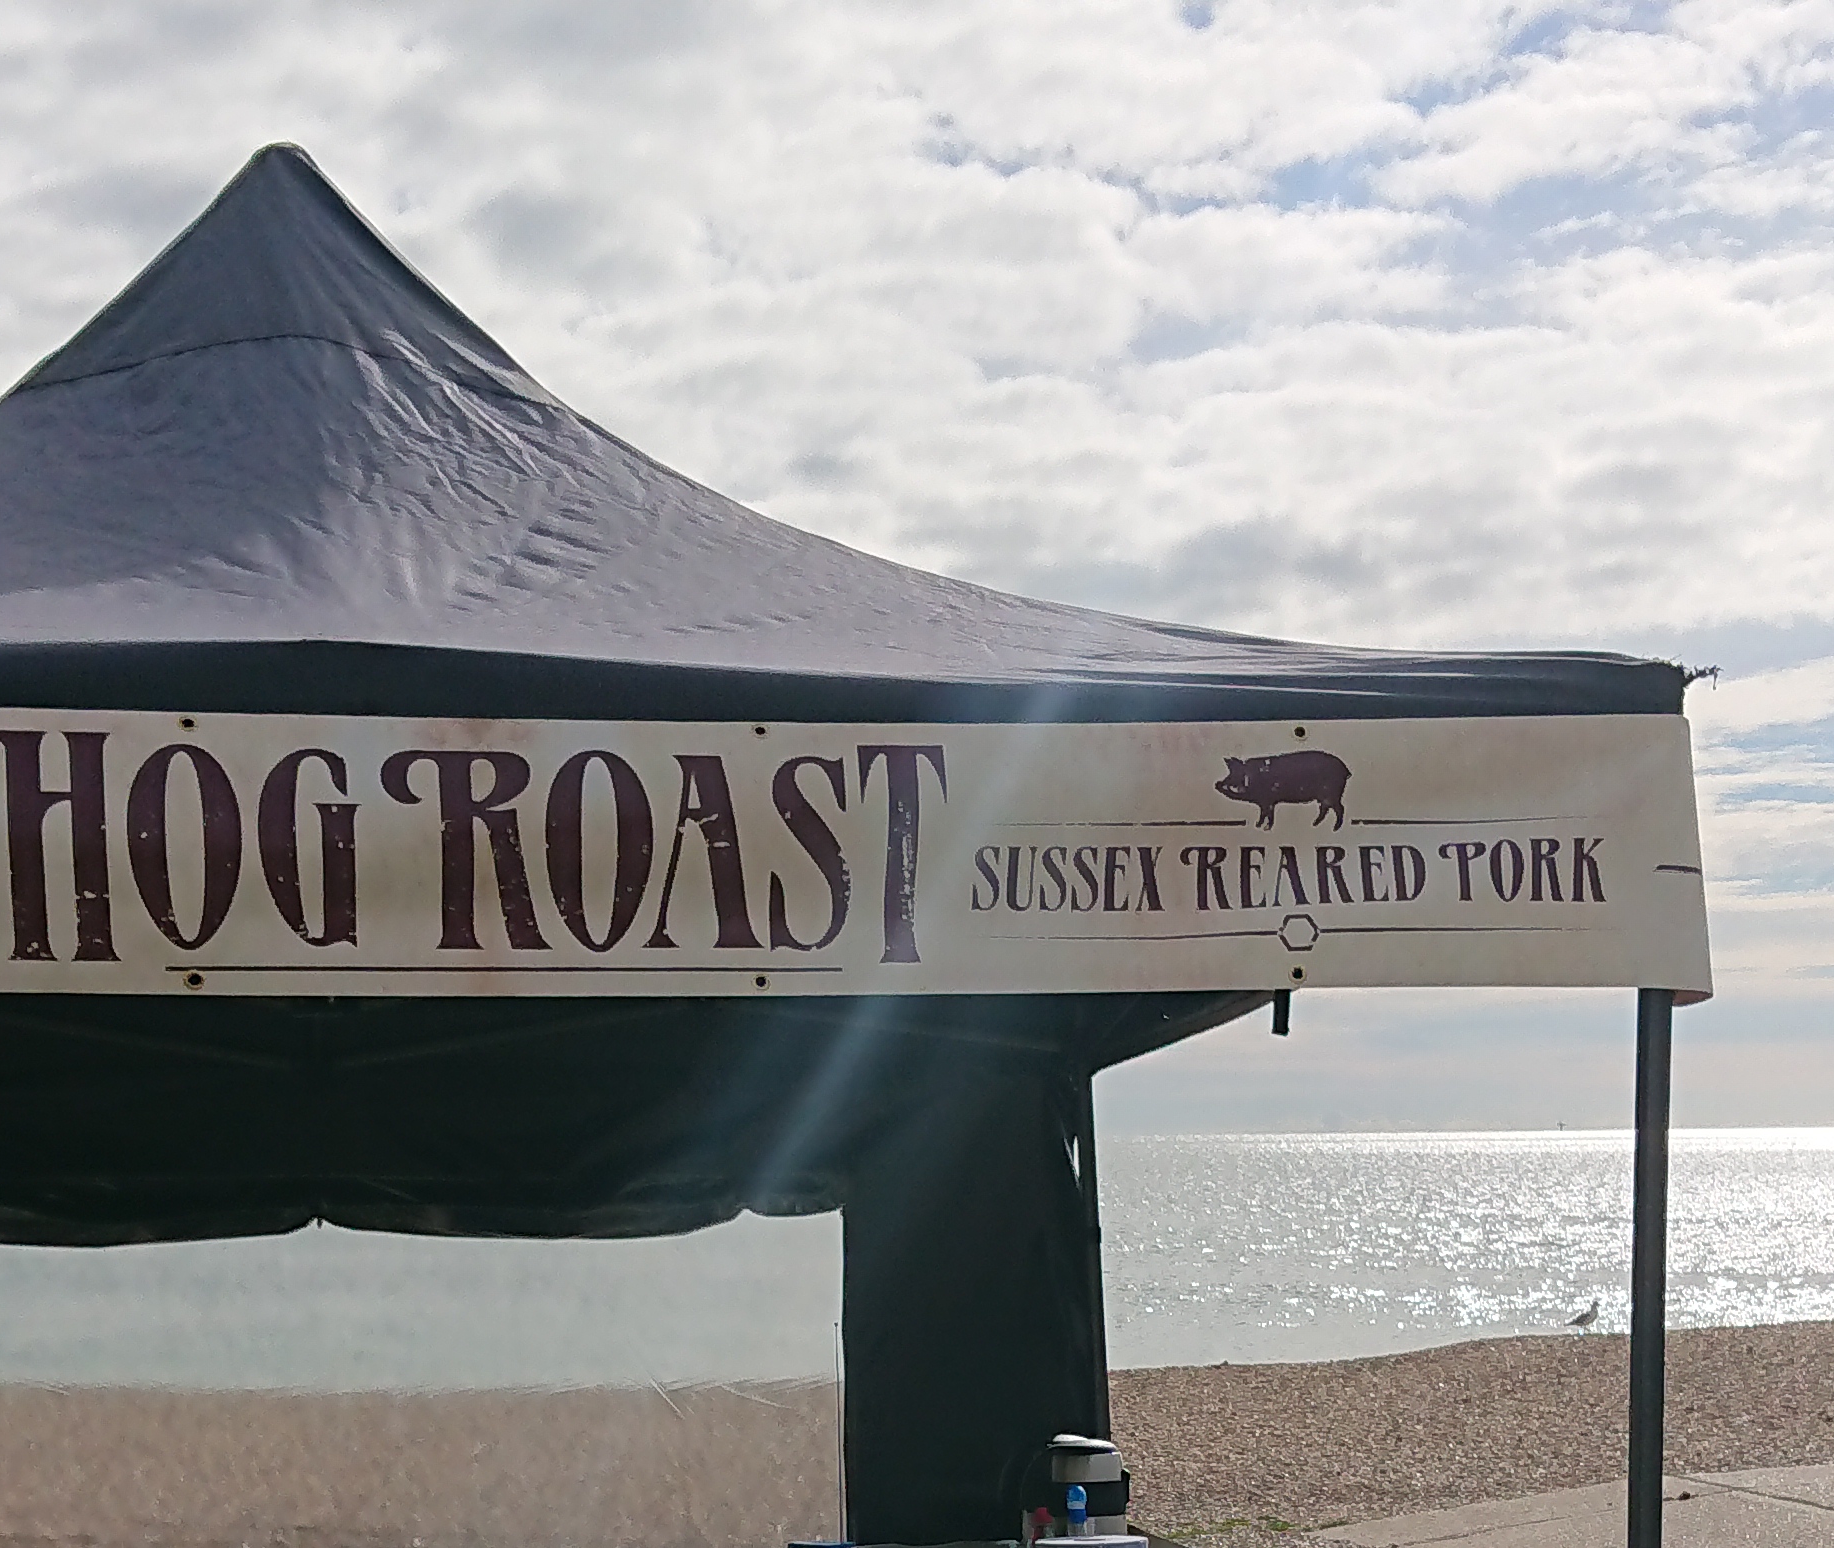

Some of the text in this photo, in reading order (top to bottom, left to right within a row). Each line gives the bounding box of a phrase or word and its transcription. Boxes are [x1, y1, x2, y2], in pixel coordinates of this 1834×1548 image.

[379, 743, 949, 966] ROAST
[970, 835, 1608, 913] SUSSEX REARED PORK
